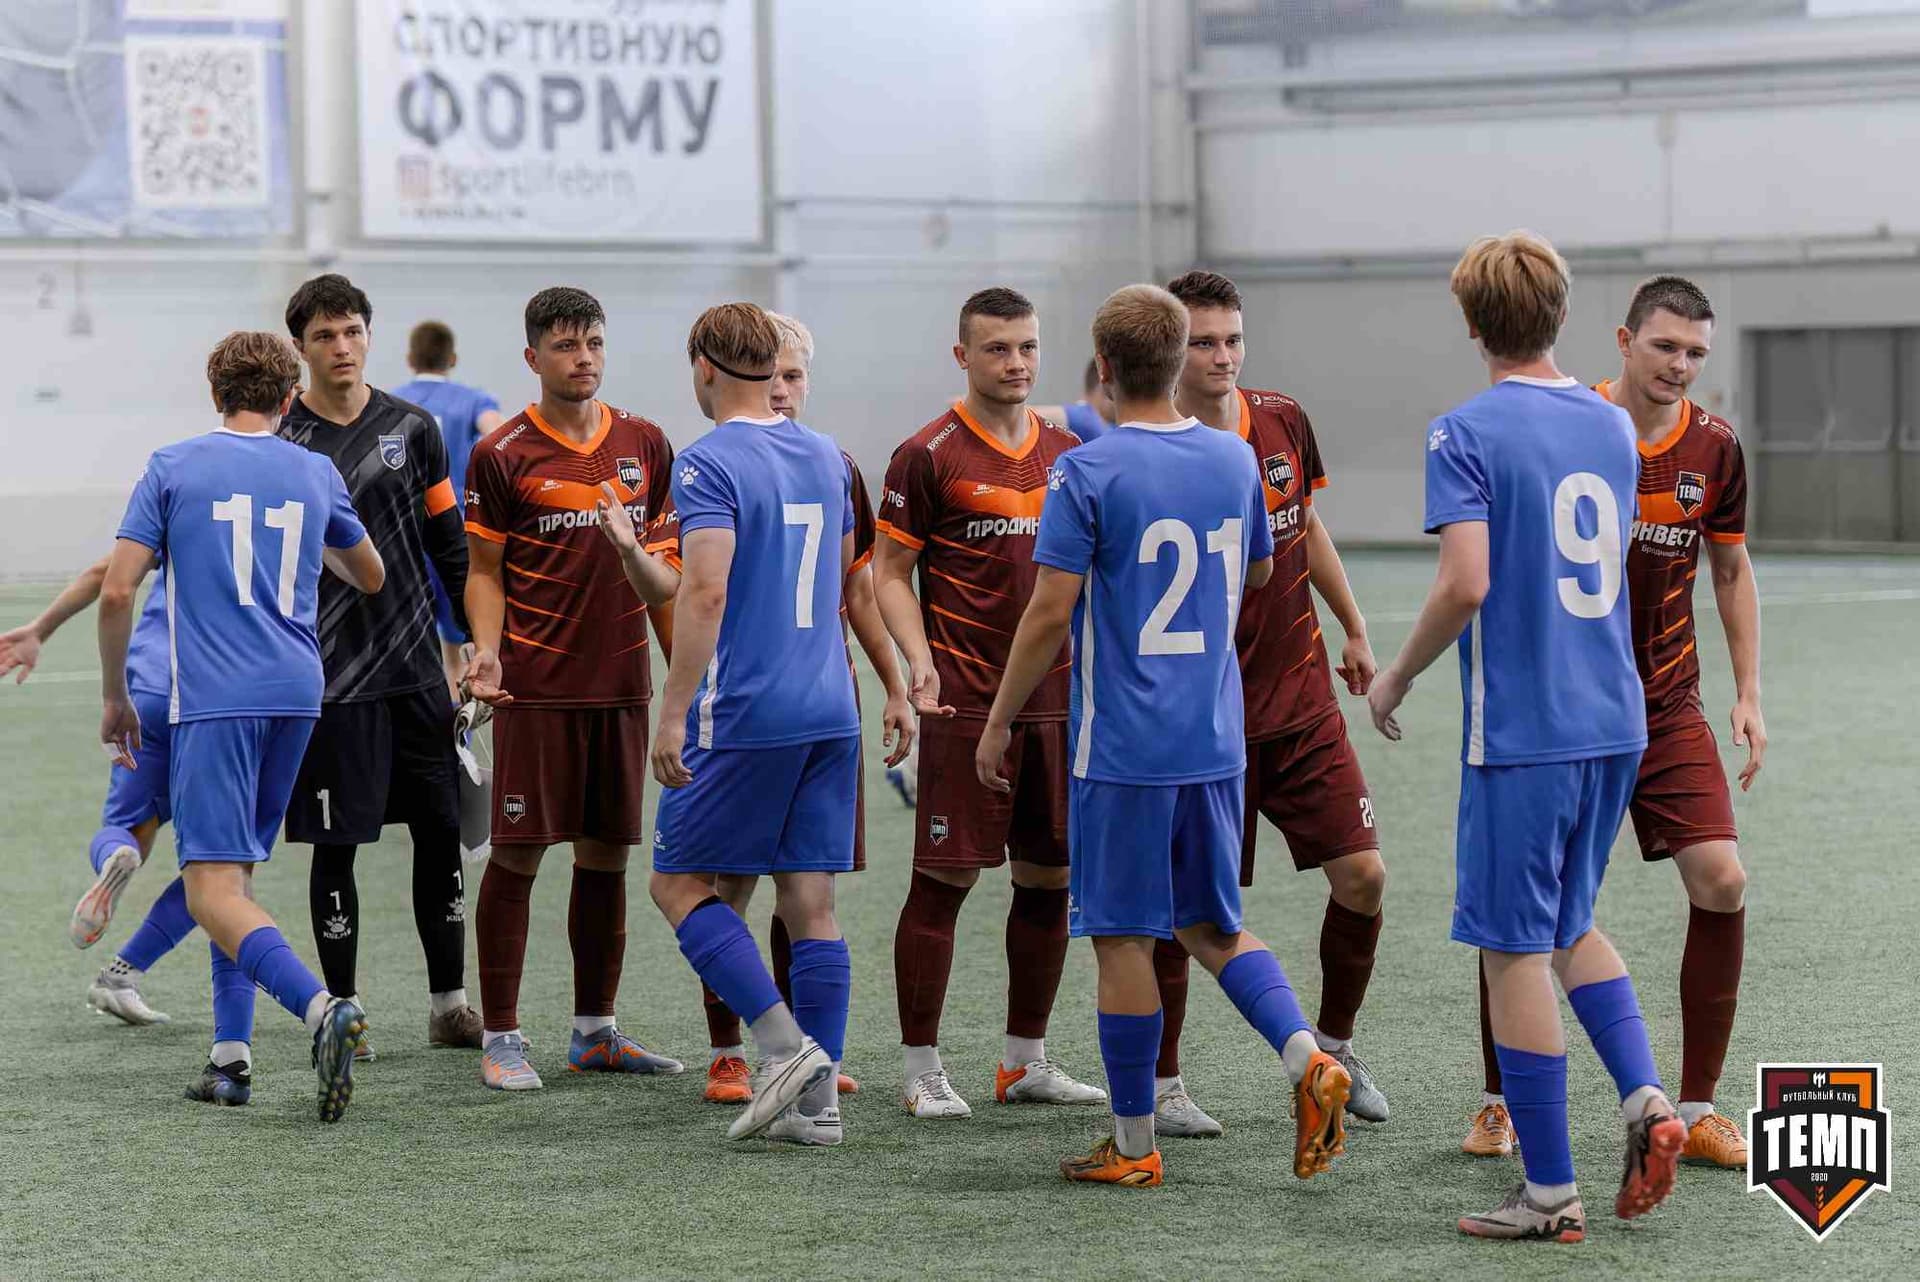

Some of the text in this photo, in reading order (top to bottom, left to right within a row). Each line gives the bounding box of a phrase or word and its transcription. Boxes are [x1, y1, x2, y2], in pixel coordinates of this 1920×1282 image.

[396, 13, 722, 64] СПОРТИВНУЮ
[397, 70, 720, 154] ФОРМУ
[1268, 464, 1293, 484] ТЕМП
[1679, 485, 1703, 502] ТЕМП
[538, 505, 646, 534] ПРОДИЕСТ
[967, 516, 1041, 539] ПРОДИН
[1268, 504, 1300, 532] ВЕСТ
[1554, 472, 1622, 619] 9
[1631, 520, 1697, 548] ИНВЕСТ
[213, 493, 305, 618] 11
[783, 503, 825, 628] 7
[1138, 518, 1243, 656] 21
[316, 789, 331, 831] 1
[1359, 797, 1375, 828] 2
[453, 870, 462, 890] 1
[330, 891, 340, 910] 1
